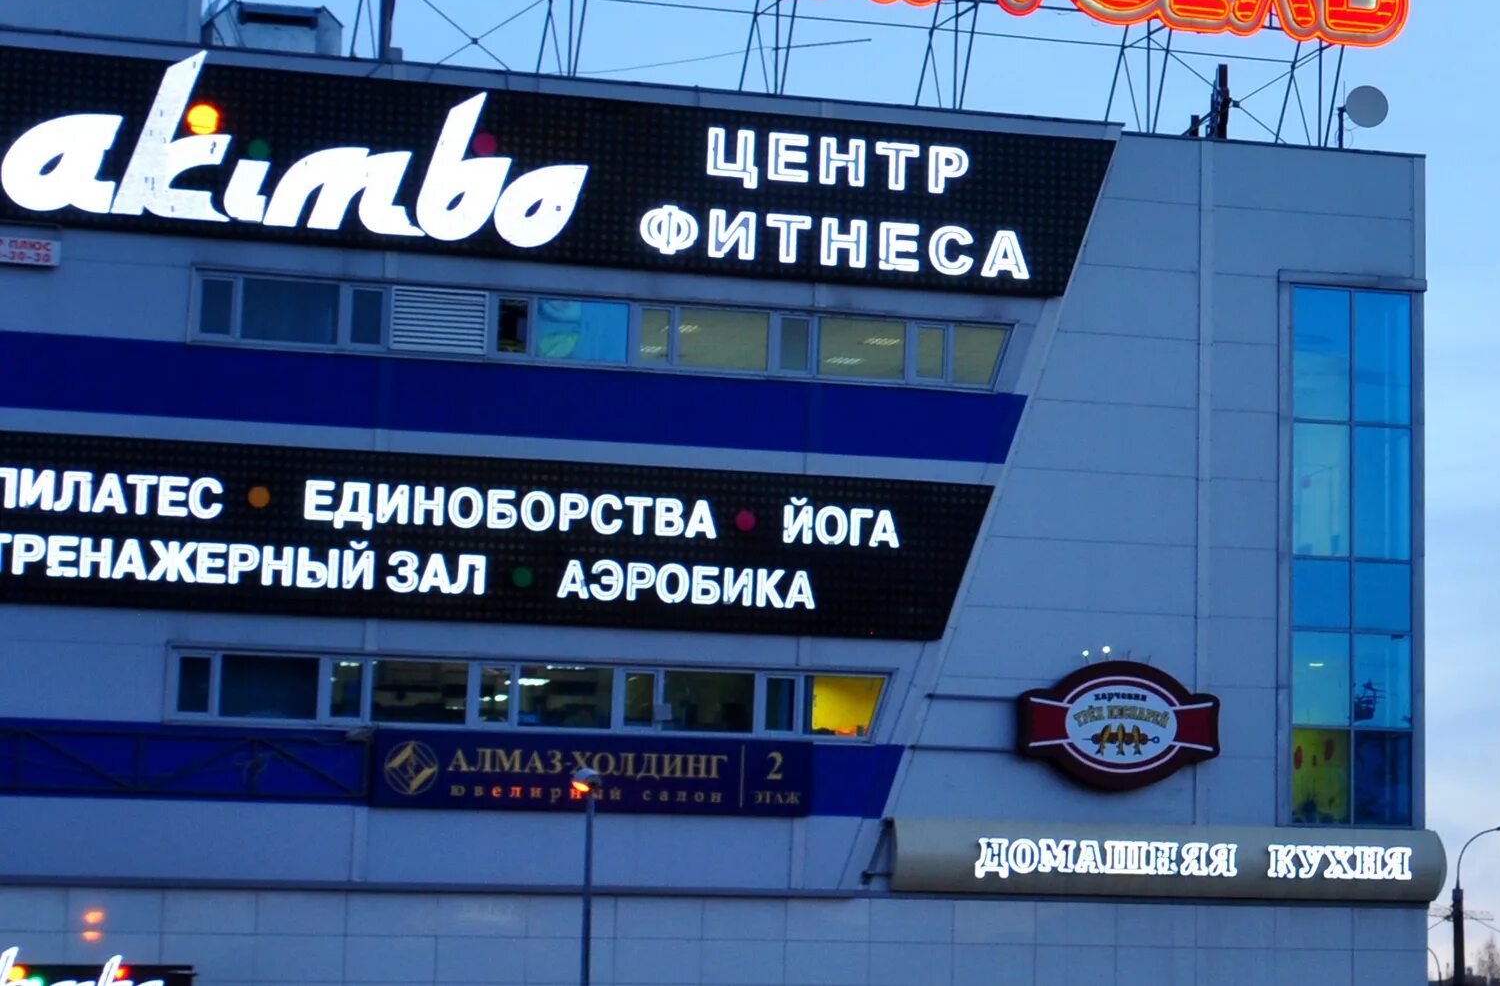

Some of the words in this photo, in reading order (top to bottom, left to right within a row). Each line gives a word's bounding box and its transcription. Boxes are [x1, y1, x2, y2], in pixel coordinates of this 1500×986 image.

[0, 50, 590, 248] akimbo
[706, 126, 970, 195] ЦЕНТР
[639, 204, 1031, 280] ФИТНЕСА
[303, 479, 718, 540] ЕДИНОБОРСТВА
[782, 497, 900, 548] ЙОГА
[385, 550, 488, 596] ЗАЛ
[556, 558, 817, 611] АЭРОБИКА
[448, 747, 728, 780] АЛМАЗ-ХОЛДИНГ
[766, 750, 785, 781] 2
[642, 788, 722, 803] салон
[754, 790, 801, 805] ЭТАЖ
[975, 837, 1238, 879] ДОМАШНЯЯ
[1266, 844, 1413, 881] КУХНЯ
